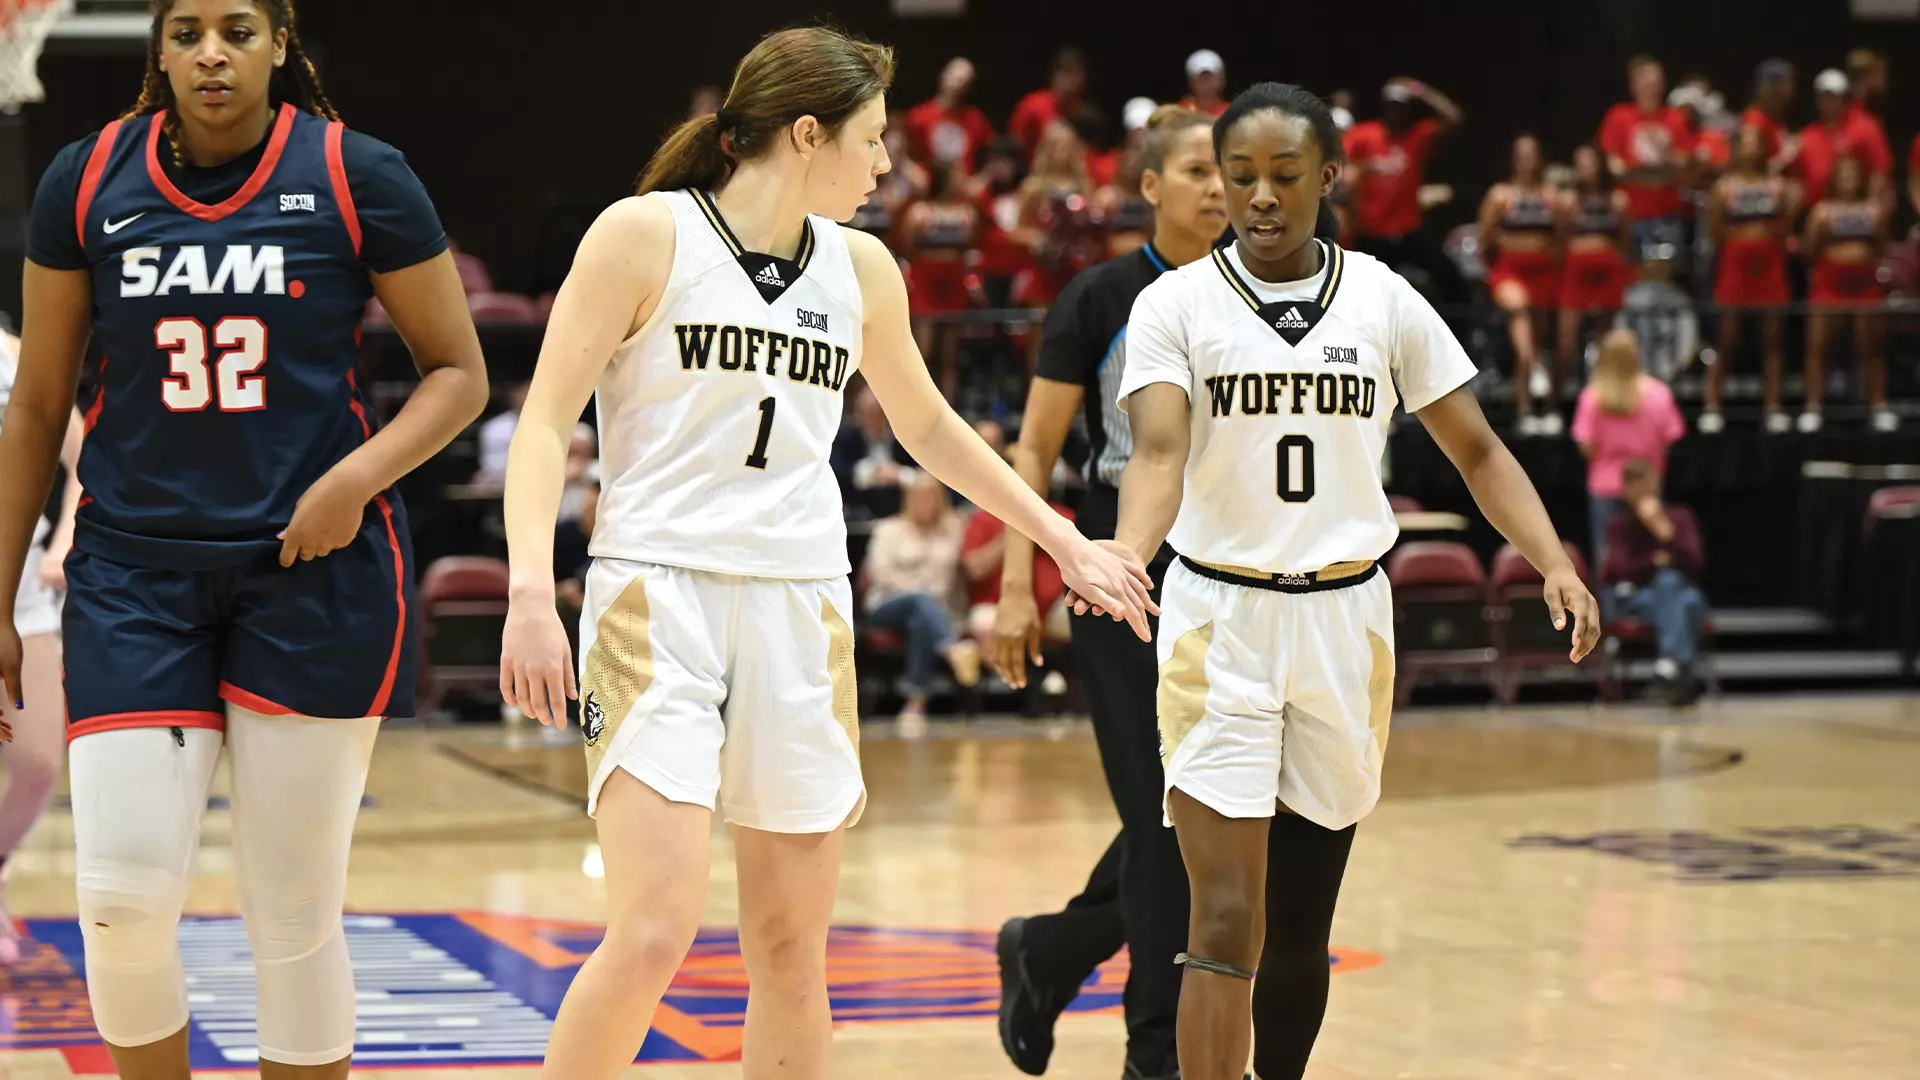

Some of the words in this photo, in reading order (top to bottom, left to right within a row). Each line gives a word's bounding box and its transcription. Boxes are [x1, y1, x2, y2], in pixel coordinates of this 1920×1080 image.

[755, 274, 785, 287] adidas
[1275, 319, 1309, 329] adidas
[155, 316, 268, 412] 32
[674, 322, 849, 392] WOFFORD
[1205, 372, 1376, 419] WOFFORD
[744, 396, 776, 470] 1
[1276, 434, 1315, 503] 0
[1277, 575, 1310, 586] adidas
